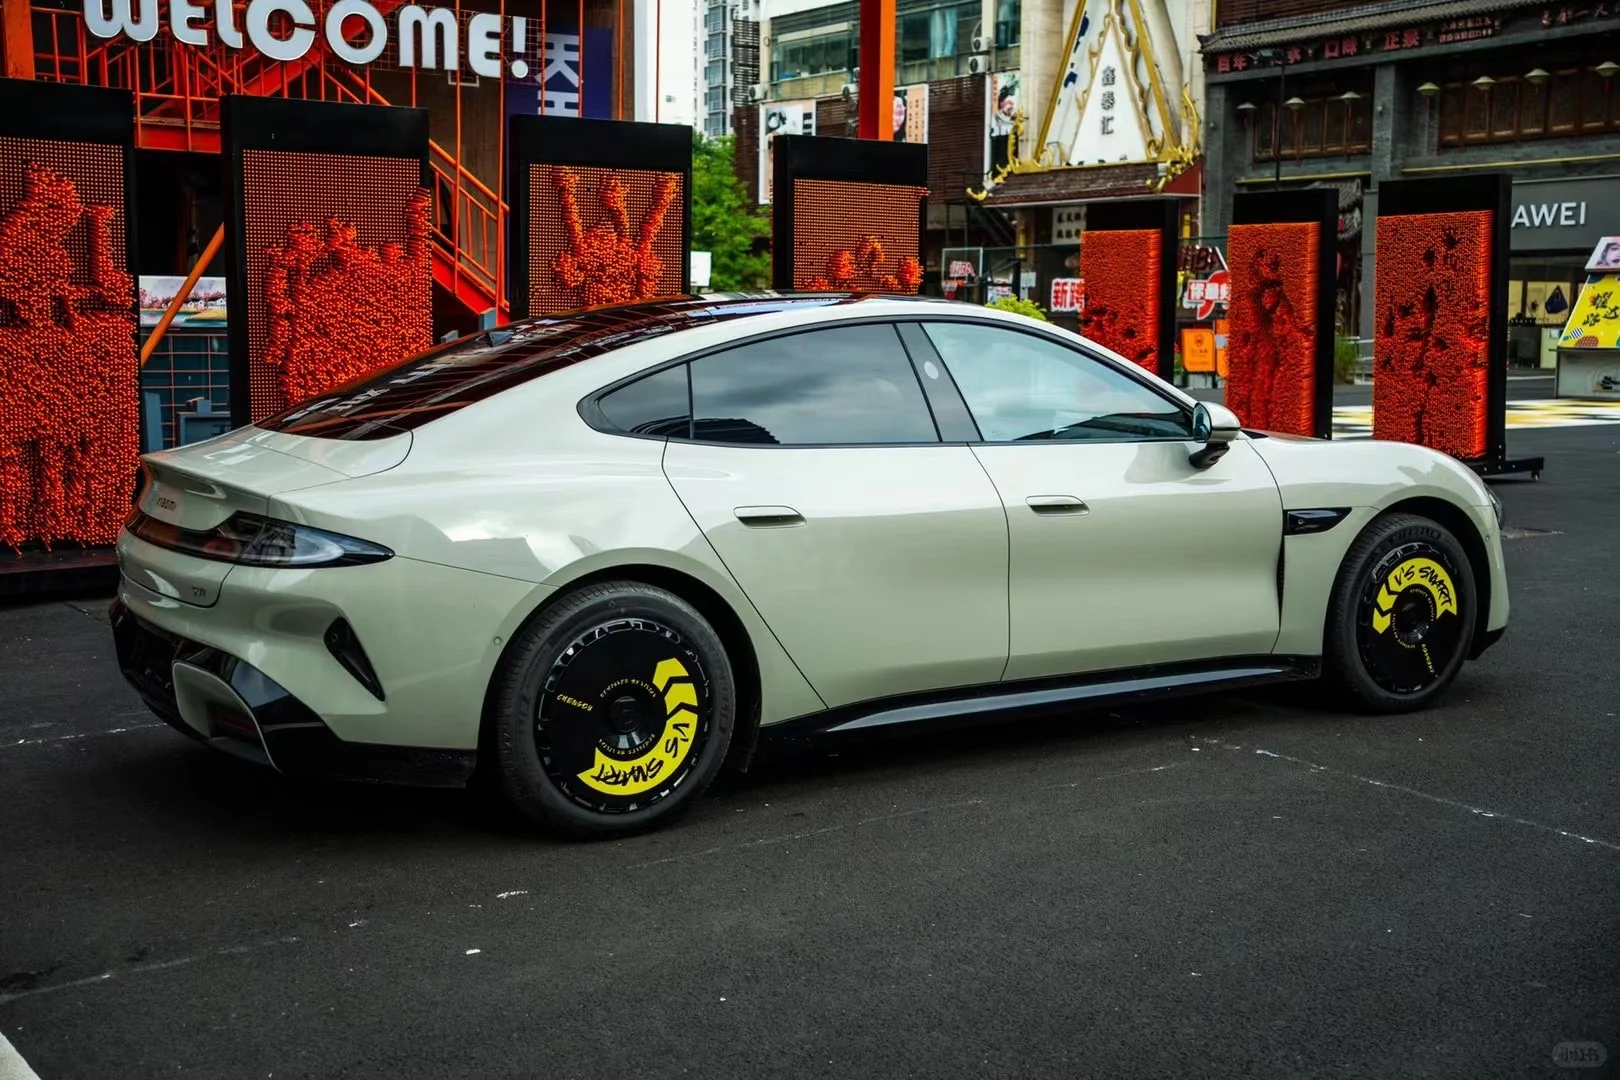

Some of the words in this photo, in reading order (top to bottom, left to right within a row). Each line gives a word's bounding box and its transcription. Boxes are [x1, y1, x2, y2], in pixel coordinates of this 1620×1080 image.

[83, 0, 530, 79] WELCOME!
[1511, 201, 1587, 228] AWEI
[1418, 566, 1452, 606] SMART
[590, 757, 665, 786] SMART
